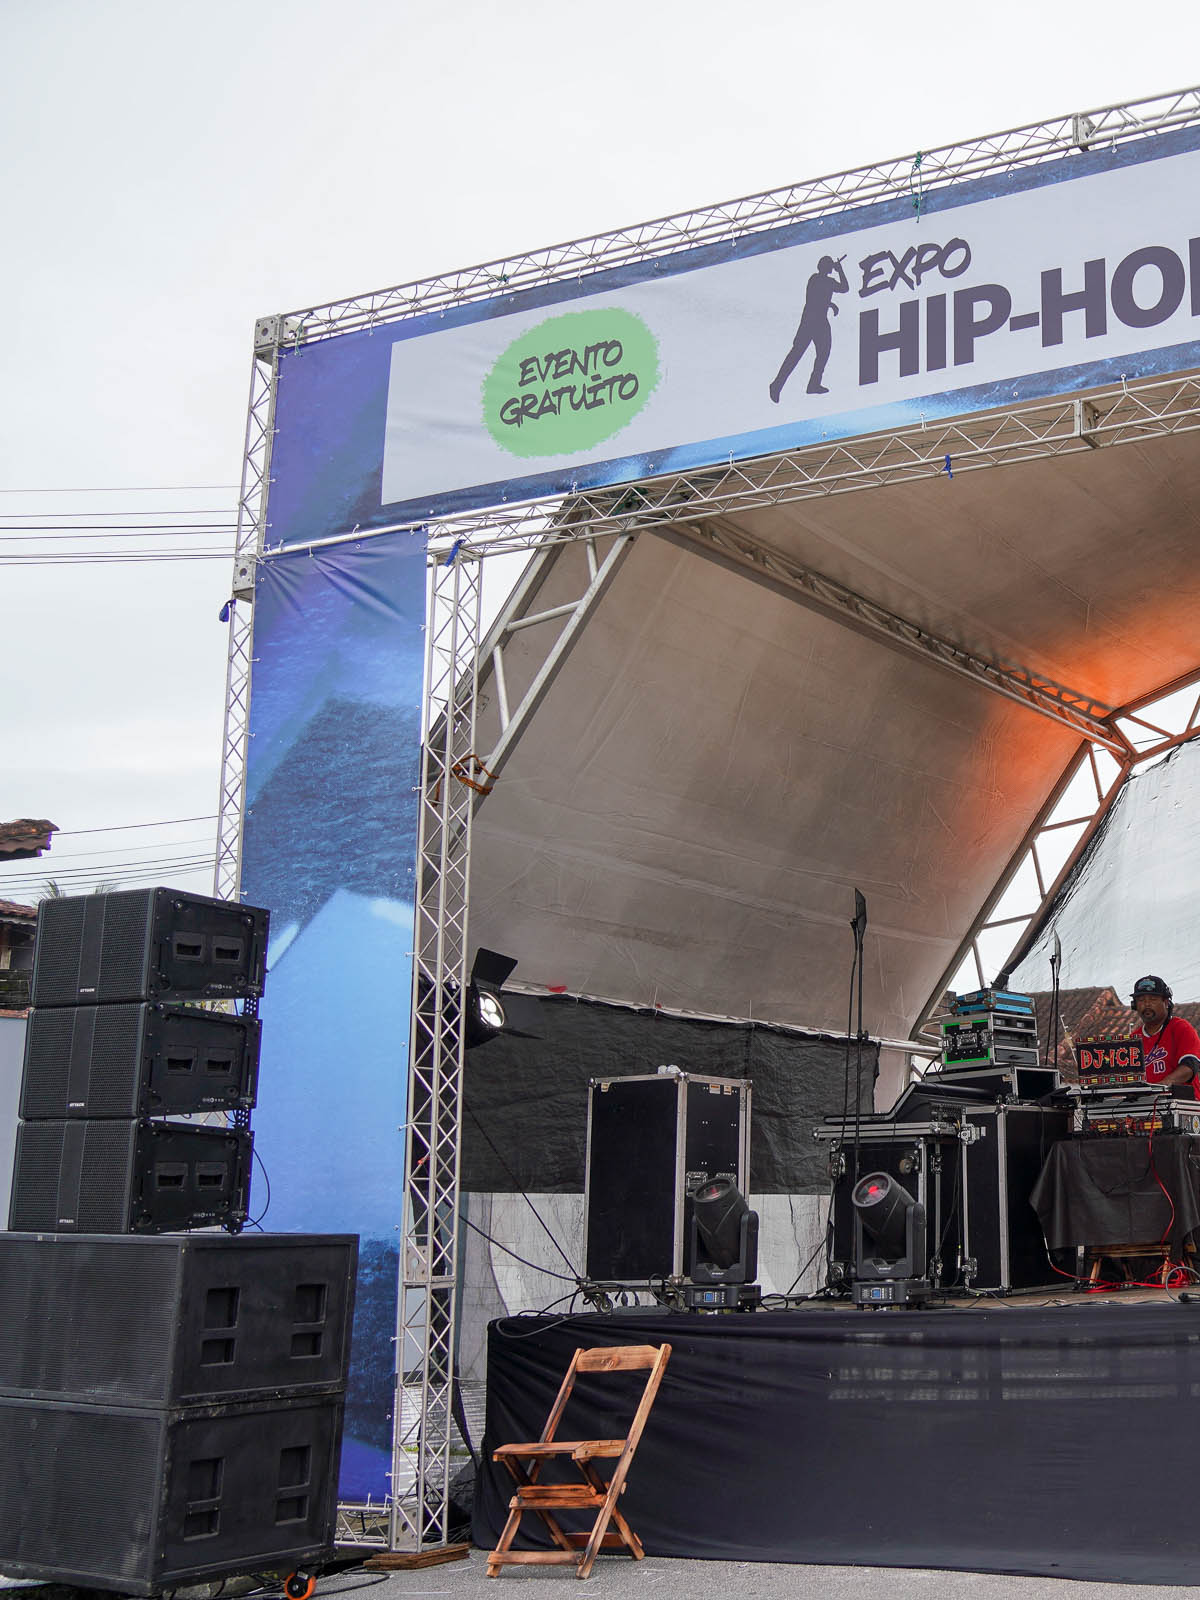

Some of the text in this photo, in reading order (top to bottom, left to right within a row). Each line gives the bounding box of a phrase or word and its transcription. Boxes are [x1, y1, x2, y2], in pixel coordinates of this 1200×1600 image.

[858, 237, 972, 298] EXPO
[518, 339, 623, 387] EVENTO
[1152, 1059, 1167, 1074] 10
